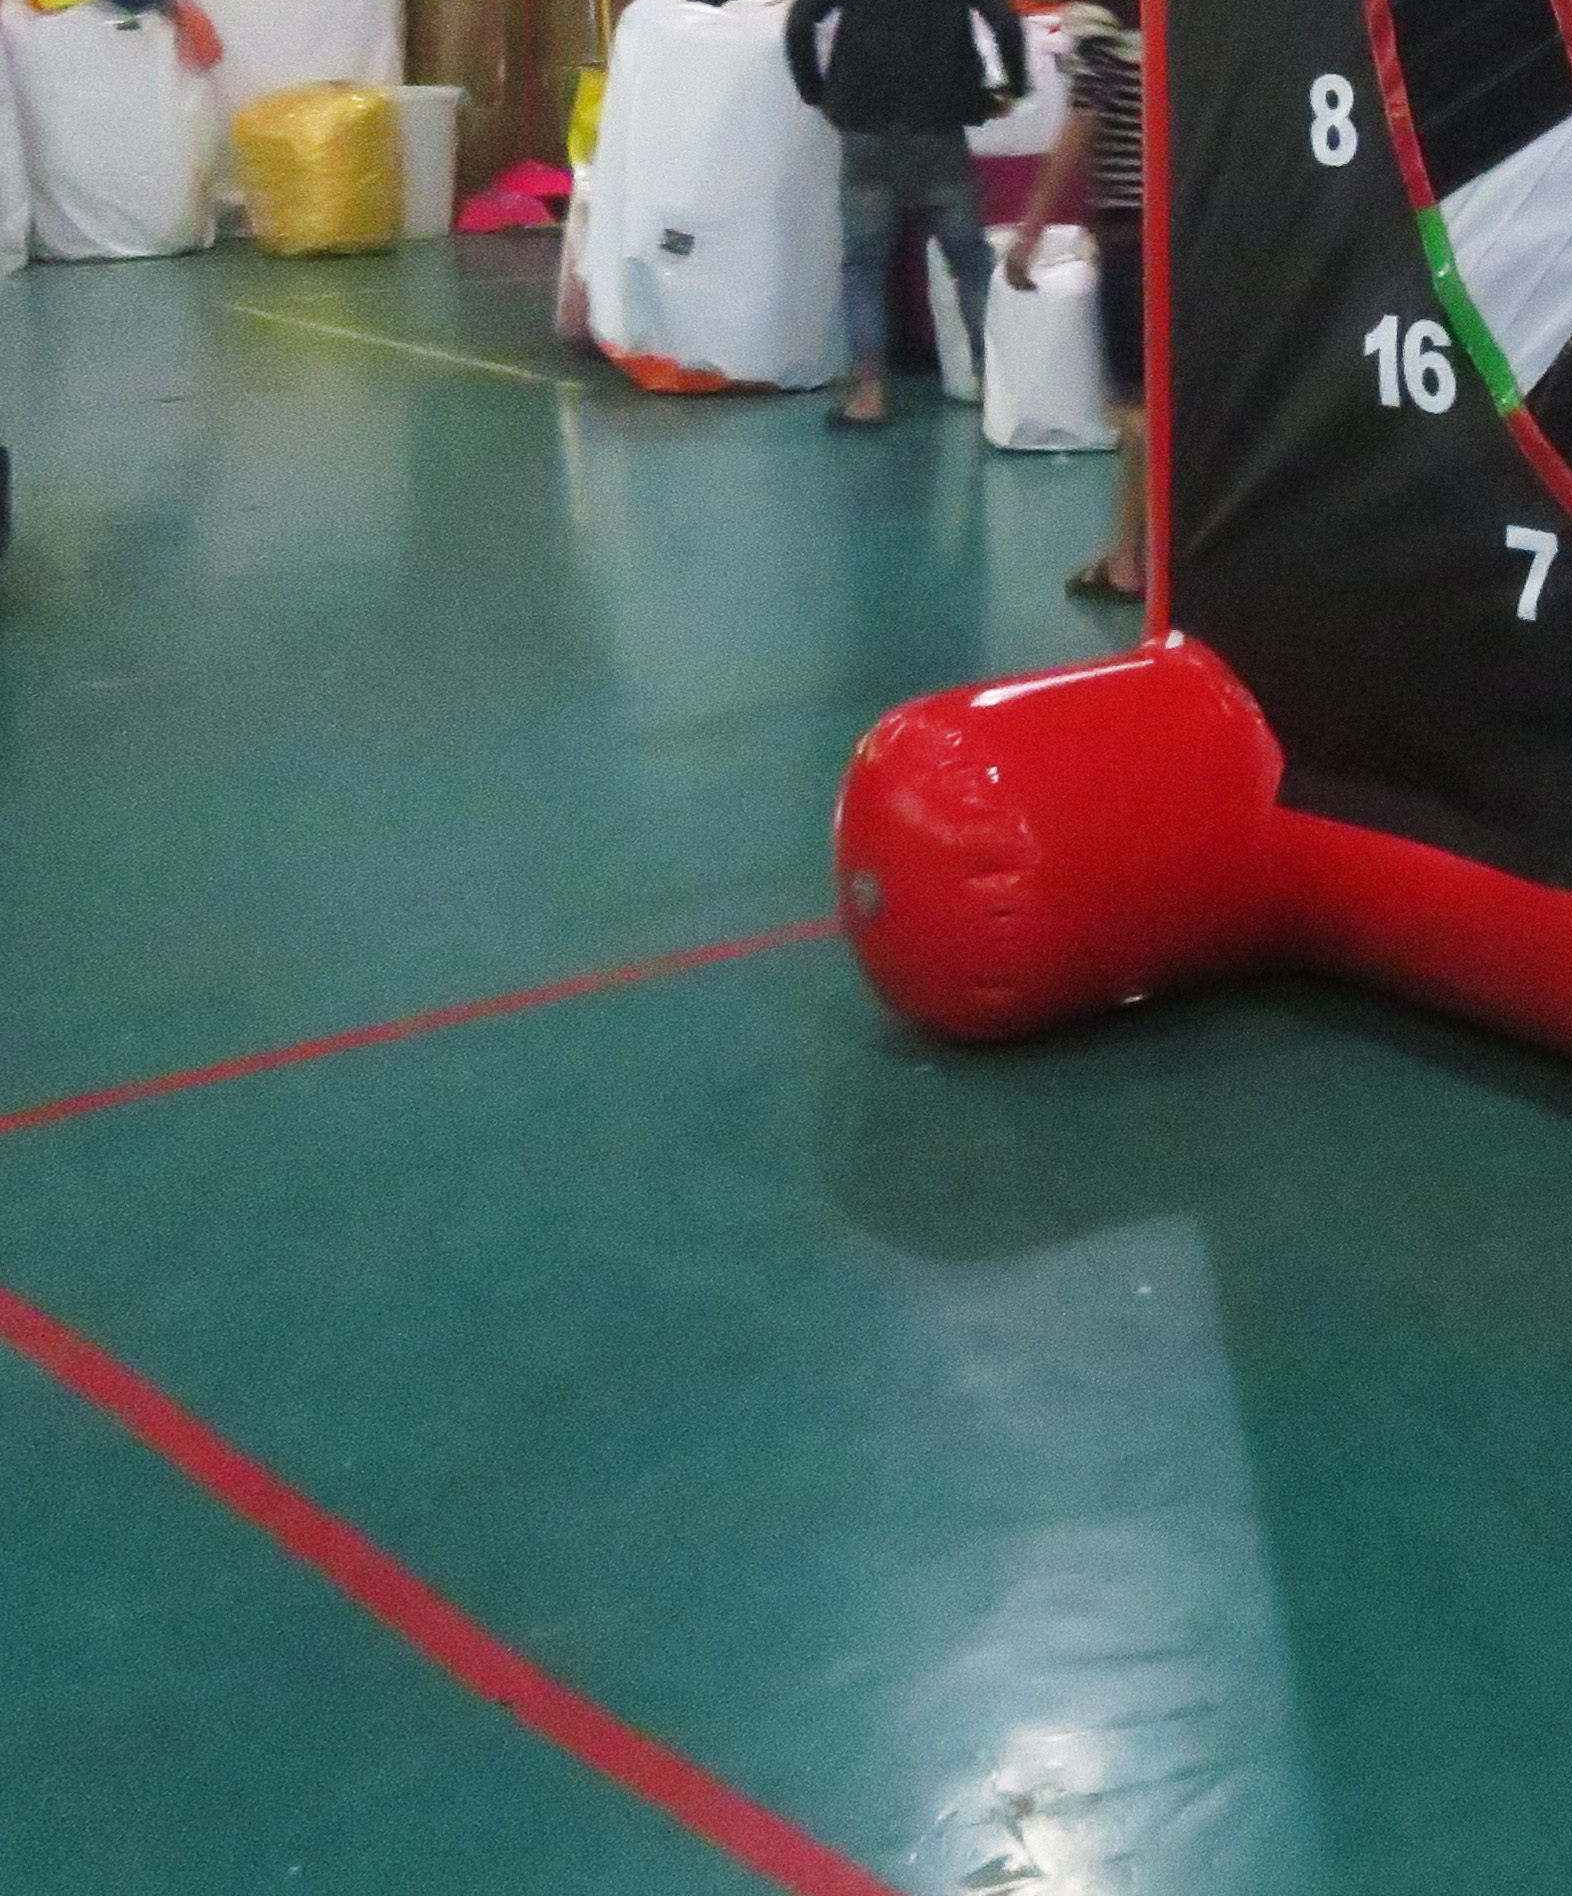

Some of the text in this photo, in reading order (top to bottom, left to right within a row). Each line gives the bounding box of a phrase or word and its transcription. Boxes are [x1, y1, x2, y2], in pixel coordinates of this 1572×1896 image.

[1310, 74, 1357, 166] 8
[1365, 315, 1456, 414] 16
[1506, 525, 1558, 620] 7
